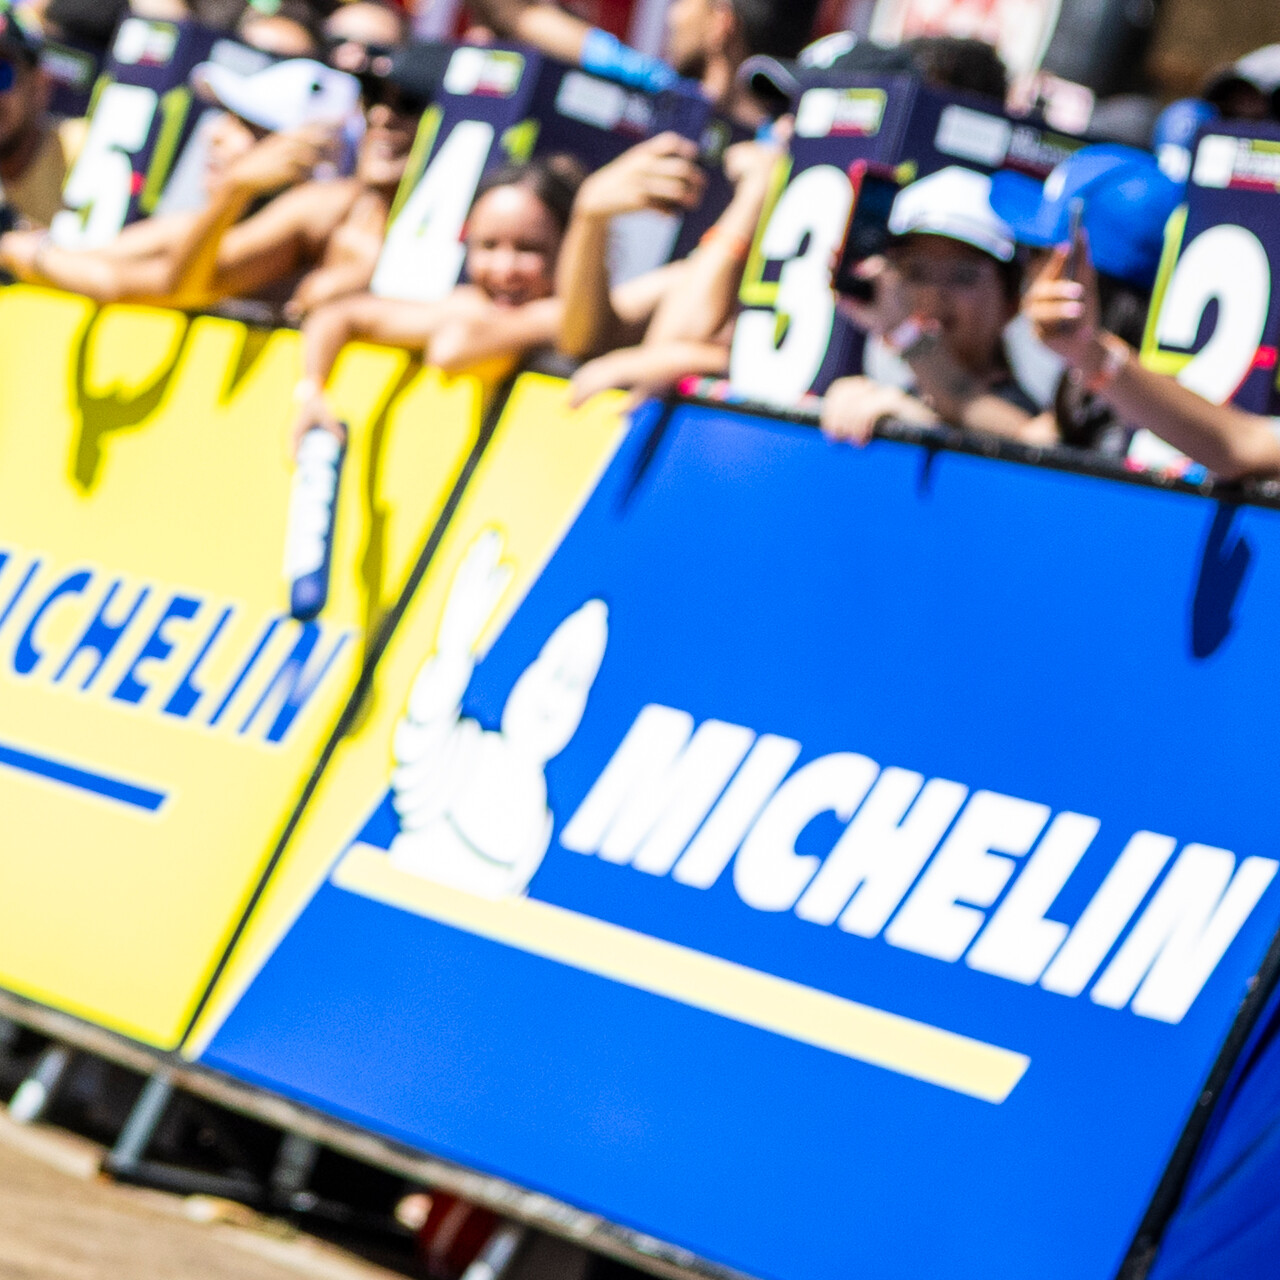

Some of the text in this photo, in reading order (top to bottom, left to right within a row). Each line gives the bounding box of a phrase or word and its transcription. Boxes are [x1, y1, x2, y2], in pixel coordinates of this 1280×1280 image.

[50, 84, 158, 246] 5
[370, 120, 495, 300] 4
[729, 165, 854, 403] 3
[1153, 225, 1271, 406] 2
[559, 703, 1280, 1024] MICHELIN
